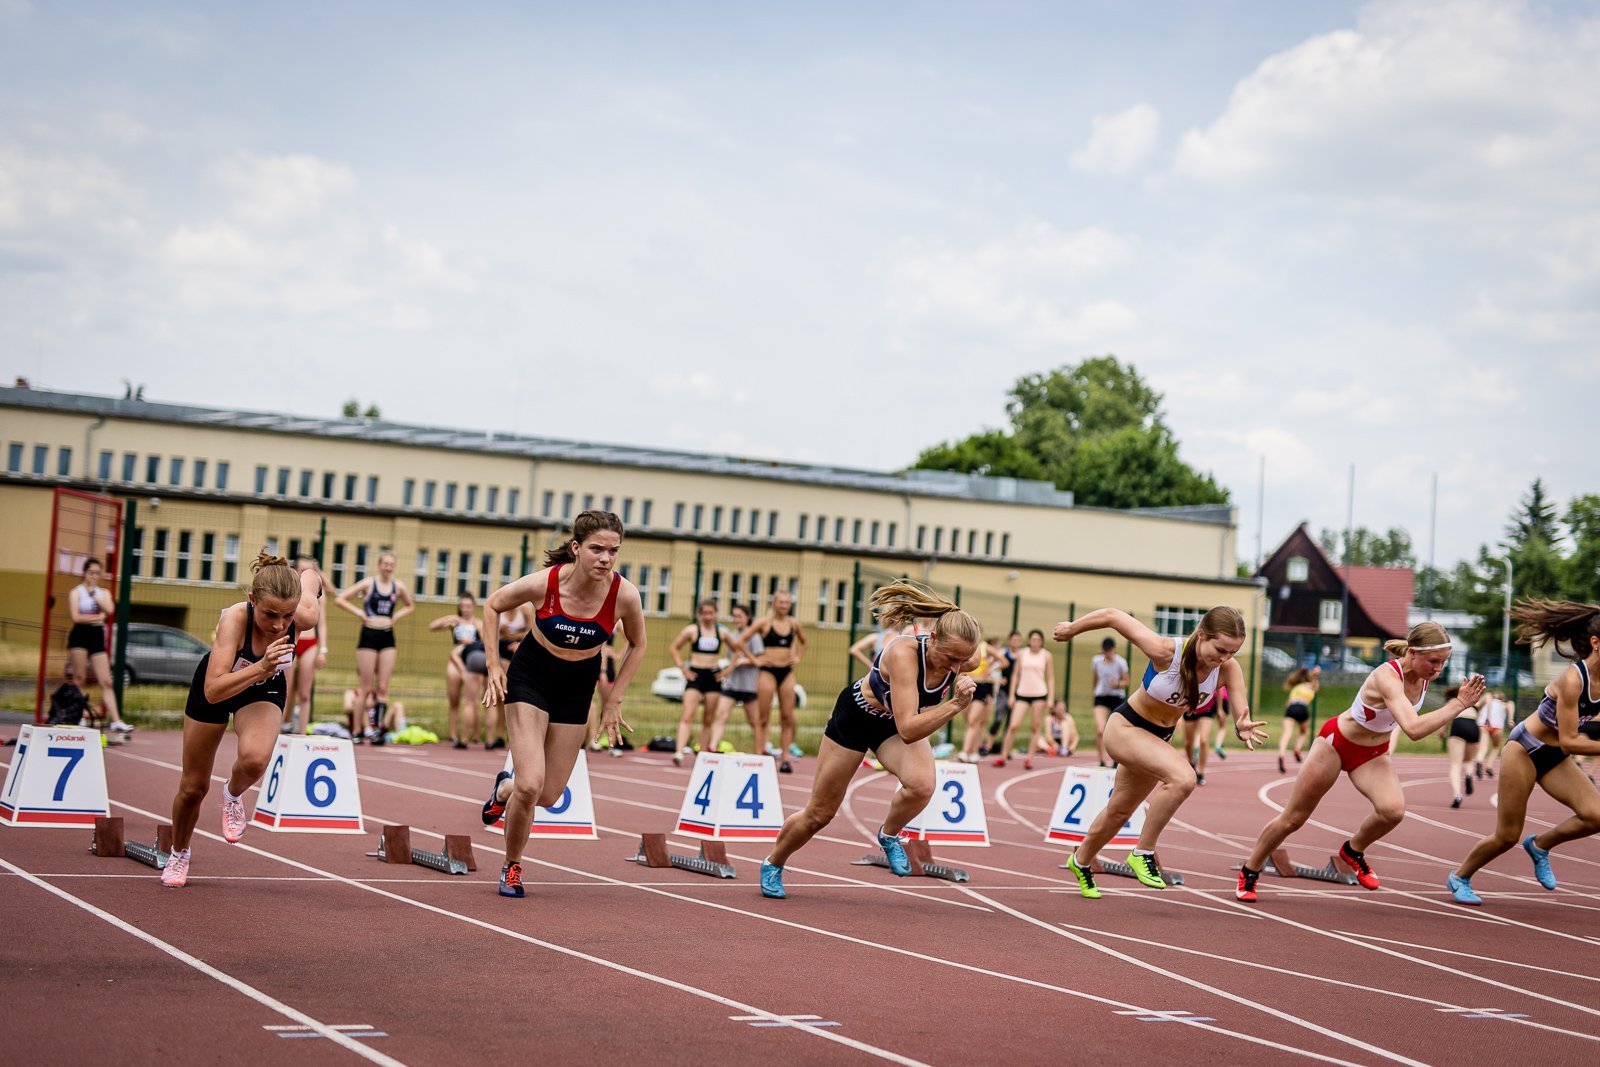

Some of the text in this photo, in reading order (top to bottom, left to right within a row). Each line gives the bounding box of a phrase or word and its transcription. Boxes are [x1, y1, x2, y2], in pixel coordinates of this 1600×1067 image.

[555, 624, 596, 636] AGROS ŻARY
[853, 692, 879, 716] NIKE
[8, 744, 27, 797] 7
[47, 747, 85, 801] 7
[267, 754, 284, 803] 6
[305, 758, 337, 808] 6
[694, 770, 714, 816] 4
[736, 773, 764, 819] 4
[942, 780, 966, 823] 3
[1063, 783, 1086, 825] 2
